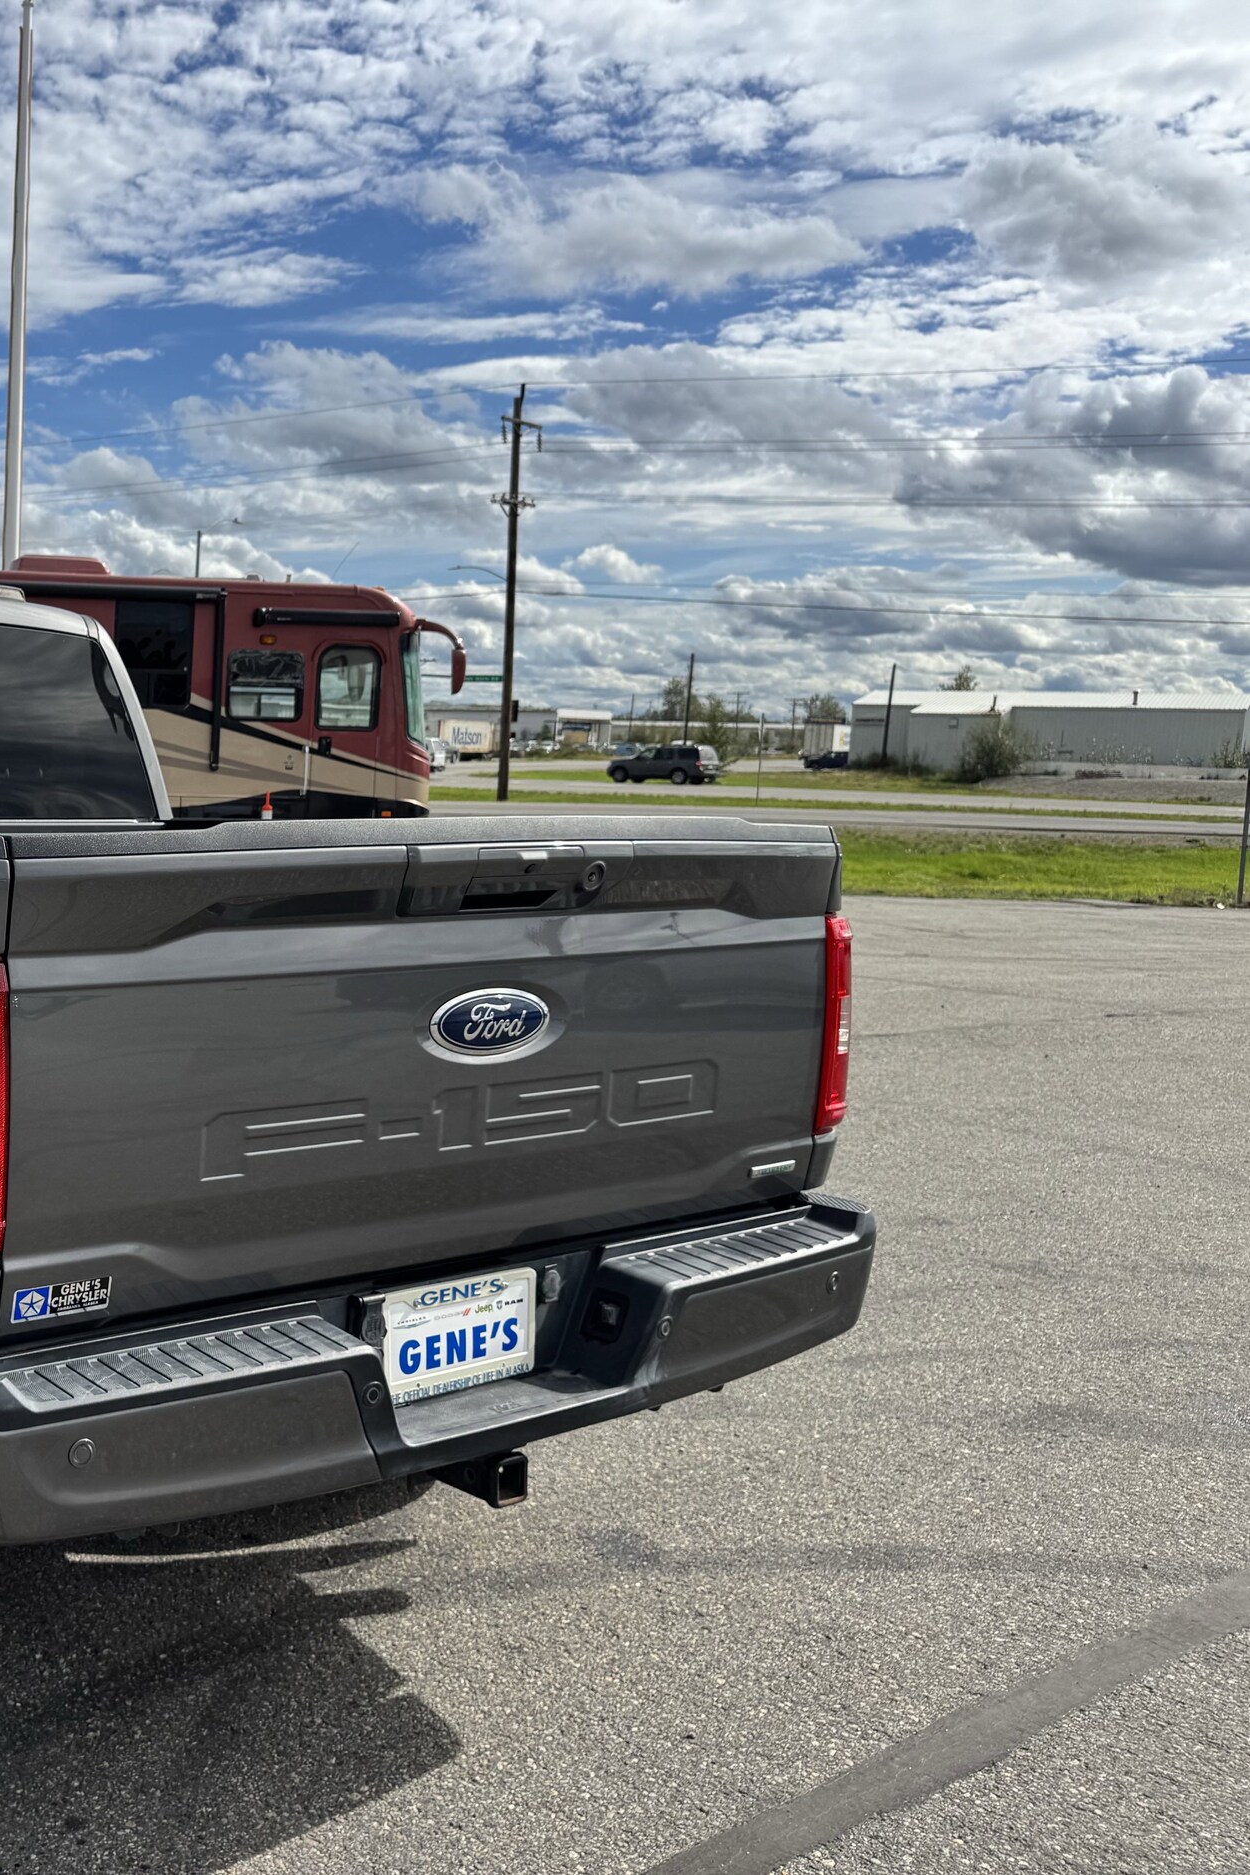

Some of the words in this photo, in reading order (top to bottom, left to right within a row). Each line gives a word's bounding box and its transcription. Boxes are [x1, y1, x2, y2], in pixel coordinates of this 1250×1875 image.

[452, 726, 481, 745] Matson
[463, 1003, 526, 1040] Ford
[200, 1058, 719, 1183] F-150
[51, 1288, 108, 1308] CHRYSLER
[60, 1278, 101, 1296] GENE'S
[420, 1278, 503, 1306] GENE'S
[474, 1303, 493, 1314] Jeep
[504, 1298, 524, 1306] RAM
[399, 1317, 518, 1375] GENE'S
[433, 1376, 471, 1395] DEALERSHIP
[472, 1373, 482, 1386] OF
[506, 1362, 530, 1376] ALASKA
